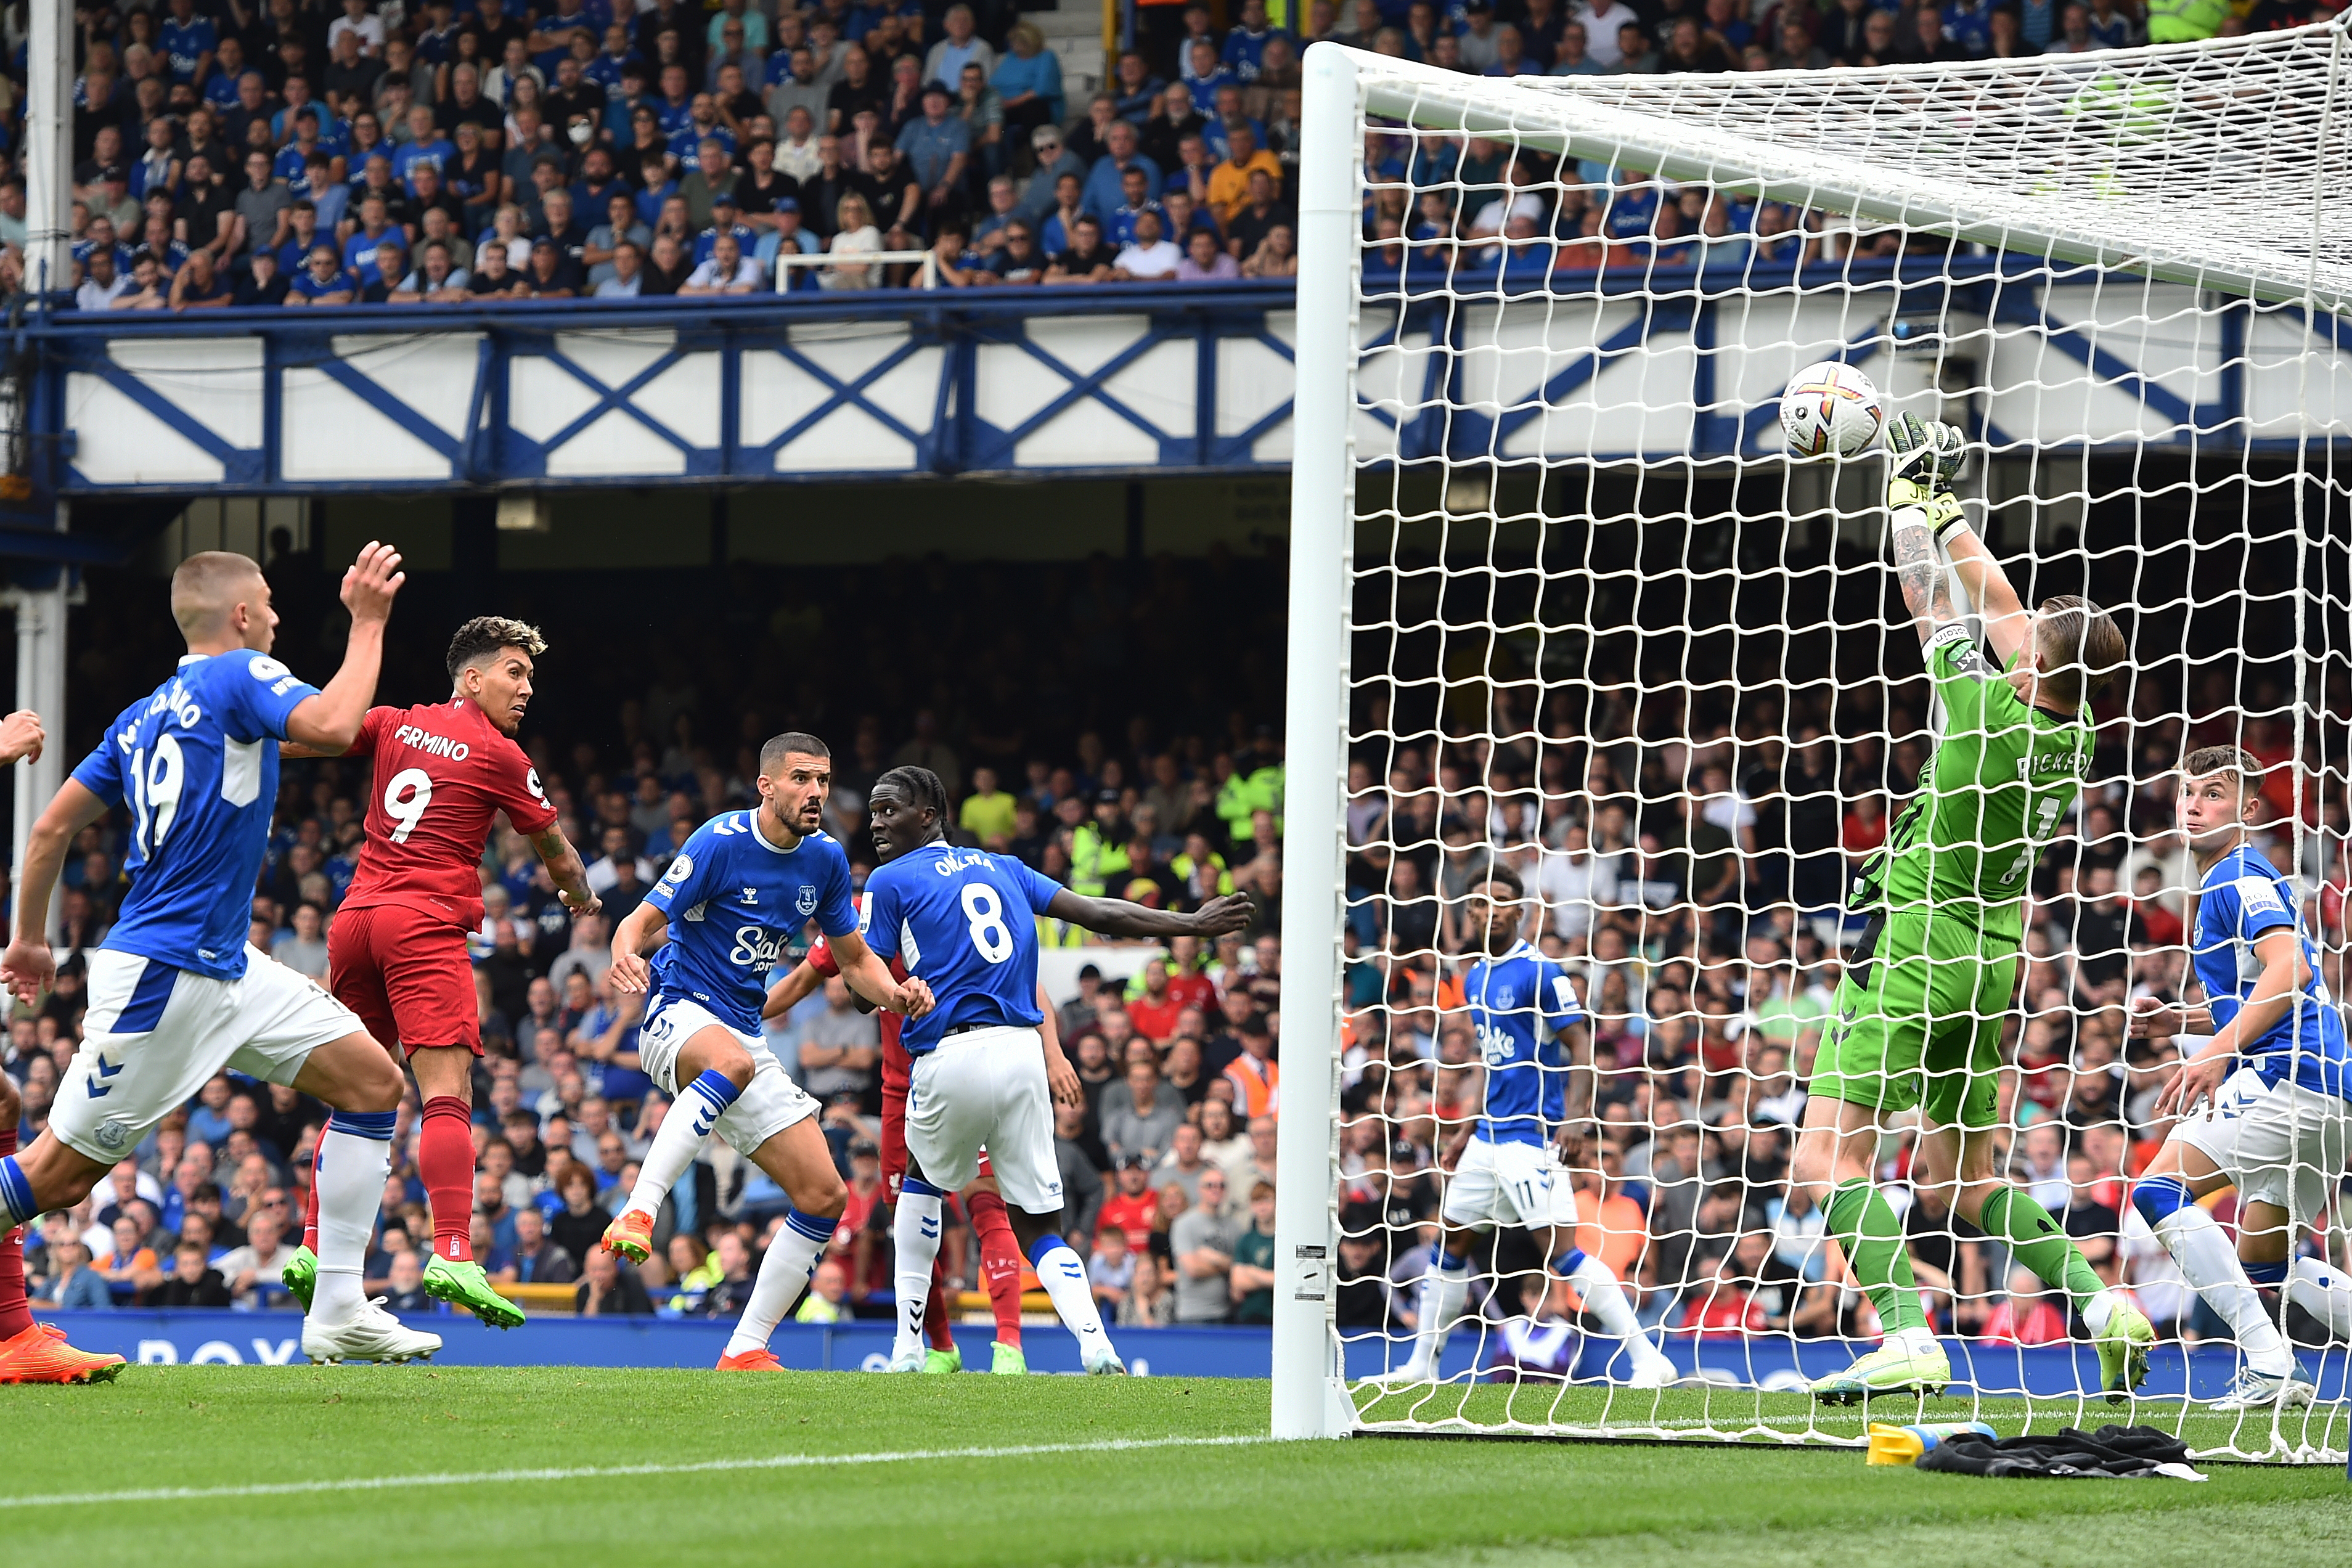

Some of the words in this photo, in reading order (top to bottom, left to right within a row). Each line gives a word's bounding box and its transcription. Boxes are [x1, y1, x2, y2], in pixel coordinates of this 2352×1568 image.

[395, 724, 469, 762] FIRMINO
[129, 733, 184, 862] 19
[385, 768, 433, 844] 9
[1999, 796, 2060, 885] 1
[962, 883, 1013, 963] 8
[1516, 1180, 1533, 1209] 11
